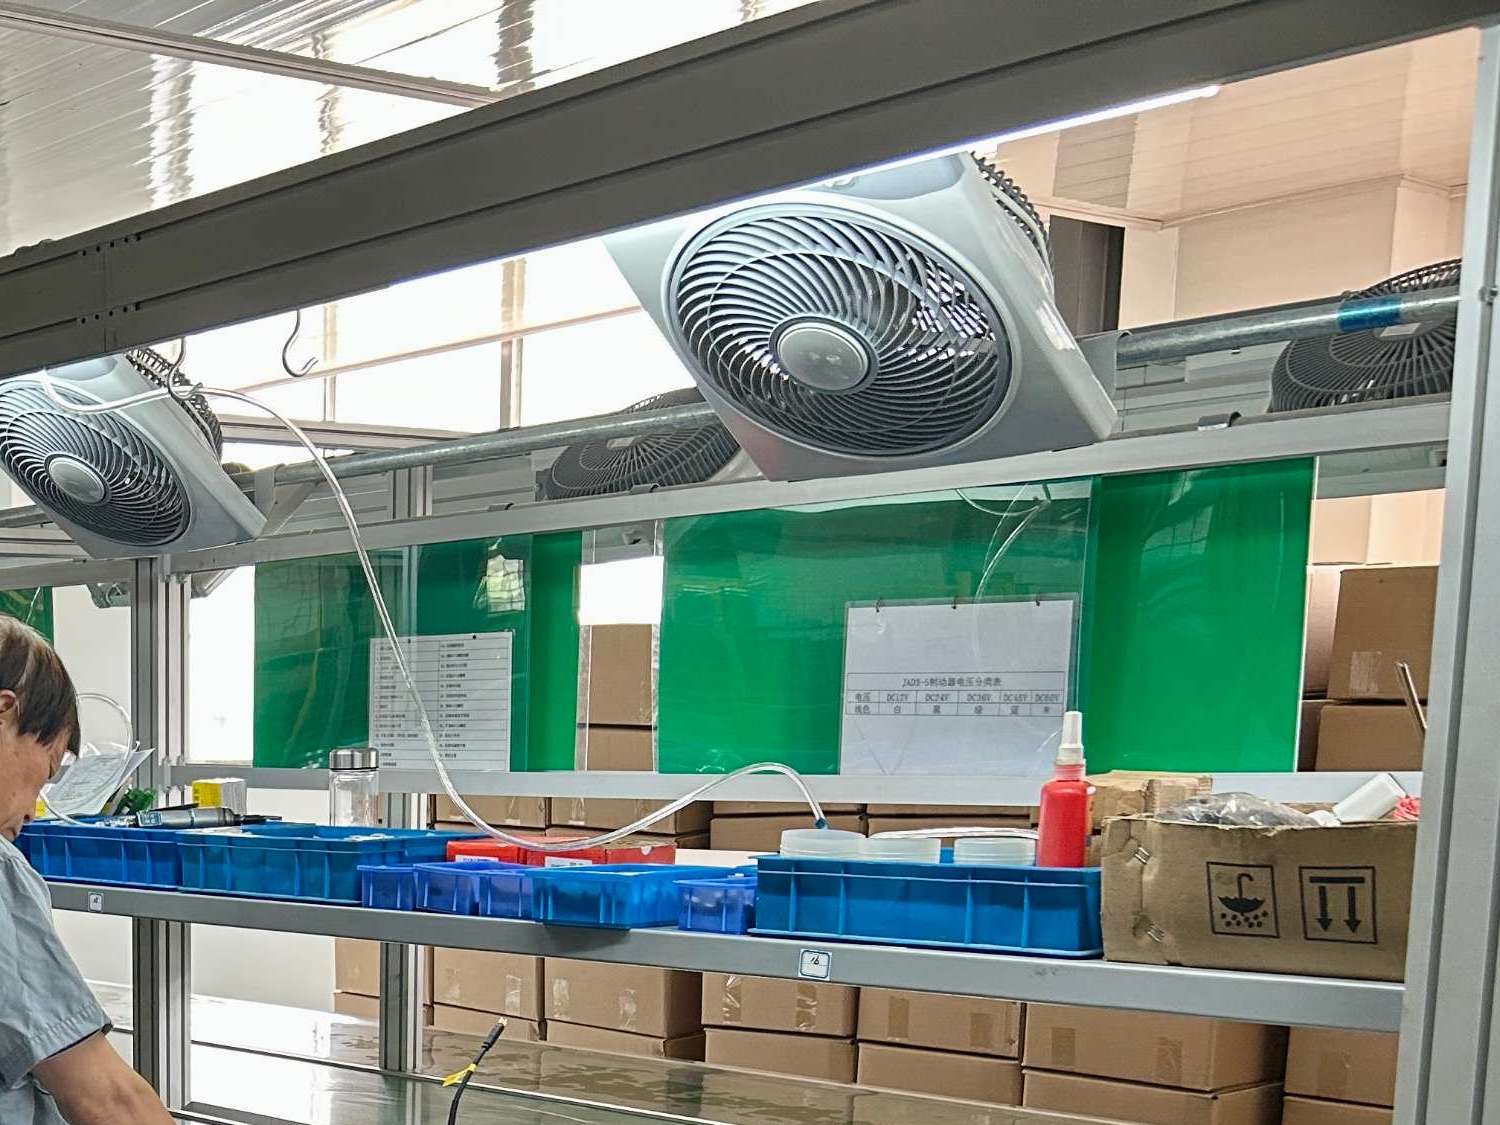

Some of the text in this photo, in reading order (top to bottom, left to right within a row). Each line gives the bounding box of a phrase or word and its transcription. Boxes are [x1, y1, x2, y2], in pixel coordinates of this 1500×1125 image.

[887, 693, 909, 702] DC12V
[925, 693, 950, 702] DC24V
[967, 693, 992, 702] DC36V
